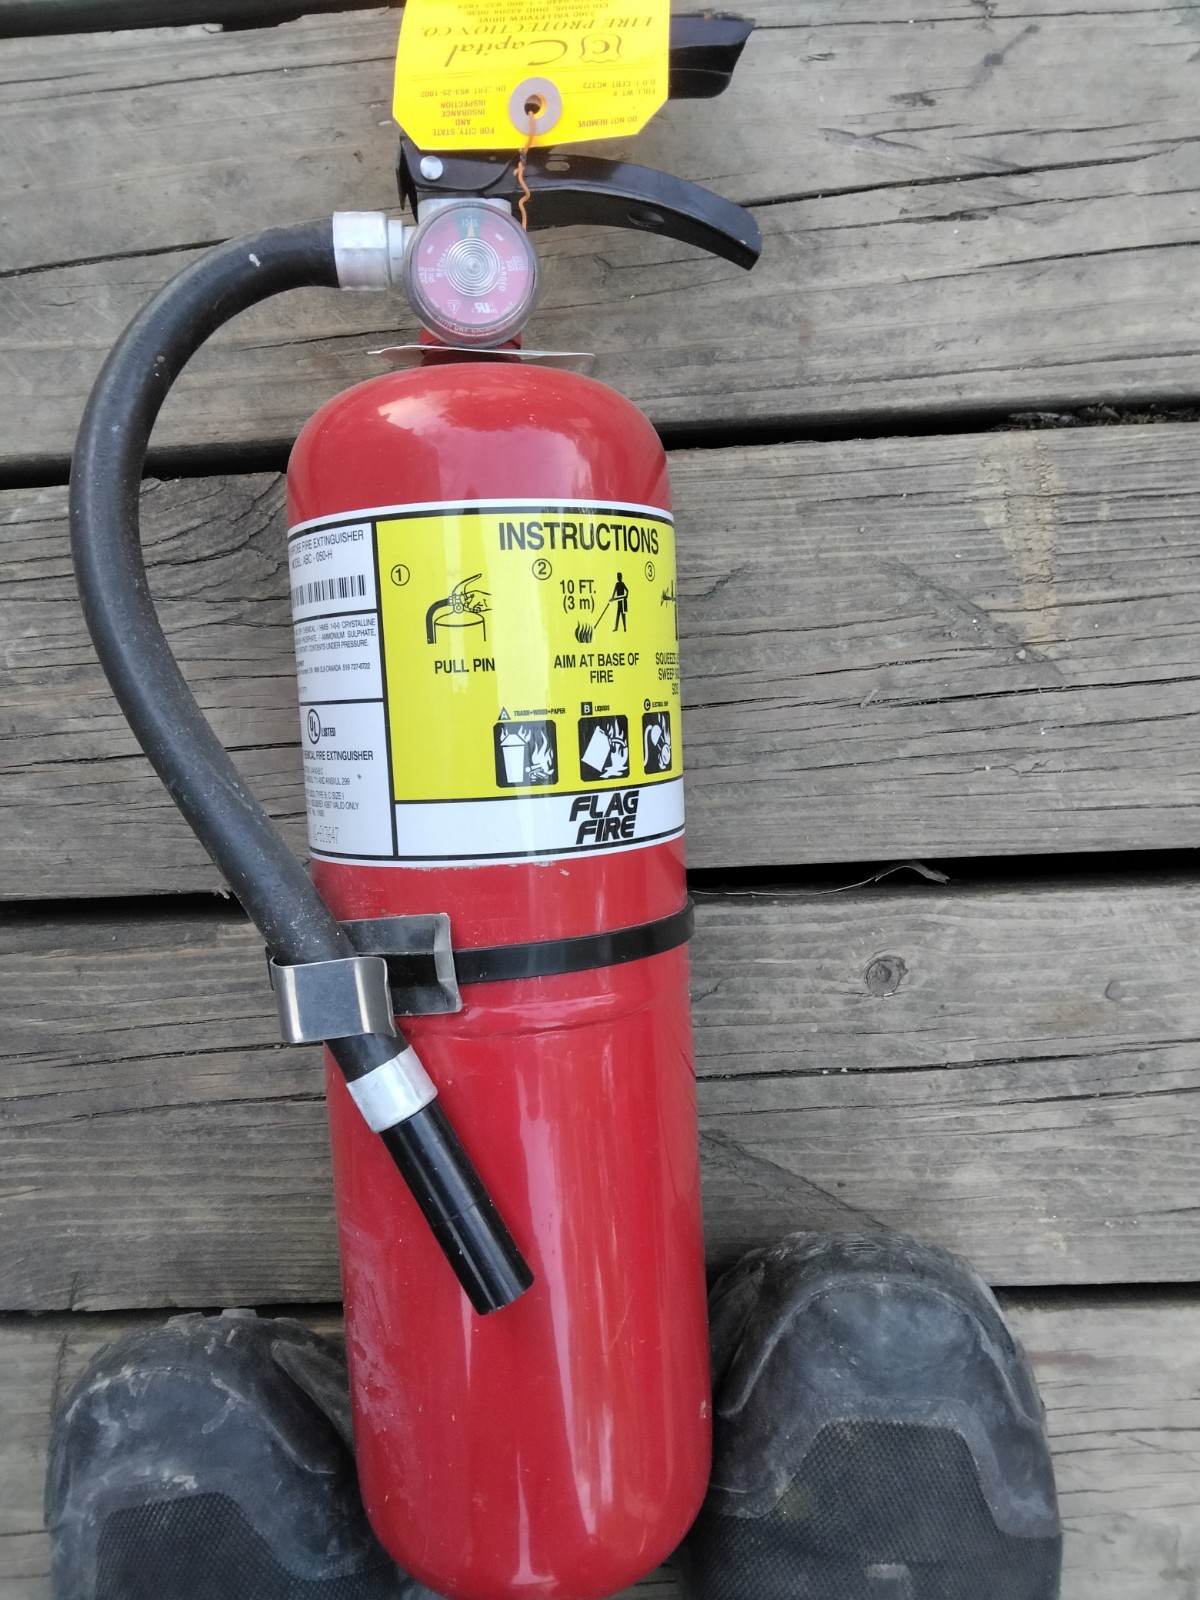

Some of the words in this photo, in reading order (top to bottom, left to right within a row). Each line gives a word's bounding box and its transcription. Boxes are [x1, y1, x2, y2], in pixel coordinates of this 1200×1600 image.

[459, 20, 595, 35] PROTECTION
[604, 17, 652, 28] FIRE
[444, 35, 568, 67] Capital
[440, 100, 486, 108] INSPECTION
[441, 108, 485, 118] INSURANCE
[578, 119, 608, 128] REMOVE
[432, 128, 456, 136] STATE
[302, 539, 312, 551] FIRE
[313, 530, 364, 549] EXTINGUISHER
[498, 521, 659, 555] INSTRUCTIONS
[560, 580, 575, 594] 10
[579, 579, 596, 594] FT.
[563, 596, 575, 613] (3
[580, 595, 595, 613] m)
[341, 618, 376, 628] CRYSTALLINE
[347, 628, 376, 638] SULPHATE,
[326, 641, 340, 650] UNDER
[341, 639, 369, 648] PRESSURE.
[554, 654, 576, 668] AIM
[579, 654, 594, 667] AT
[598, 653, 625, 666] BASE
[628, 652, 639, 666] OF
[326, 664, 341, 672] CANADA
[434, 659, 469, 674] PULL
[473, 658, 496, 672] PIN
[590, 670, 614, 683] FIRE
[321, 727, 336, 737] LISTED
[316, 750, 325, 760] FIRE
[326, 750, 374, 761] EXTINGUISHER
[345, 802, 359, 810] ONLY
[569, 790, 640, 822] FLAG
[576, 814, 636, 845] FIRE
